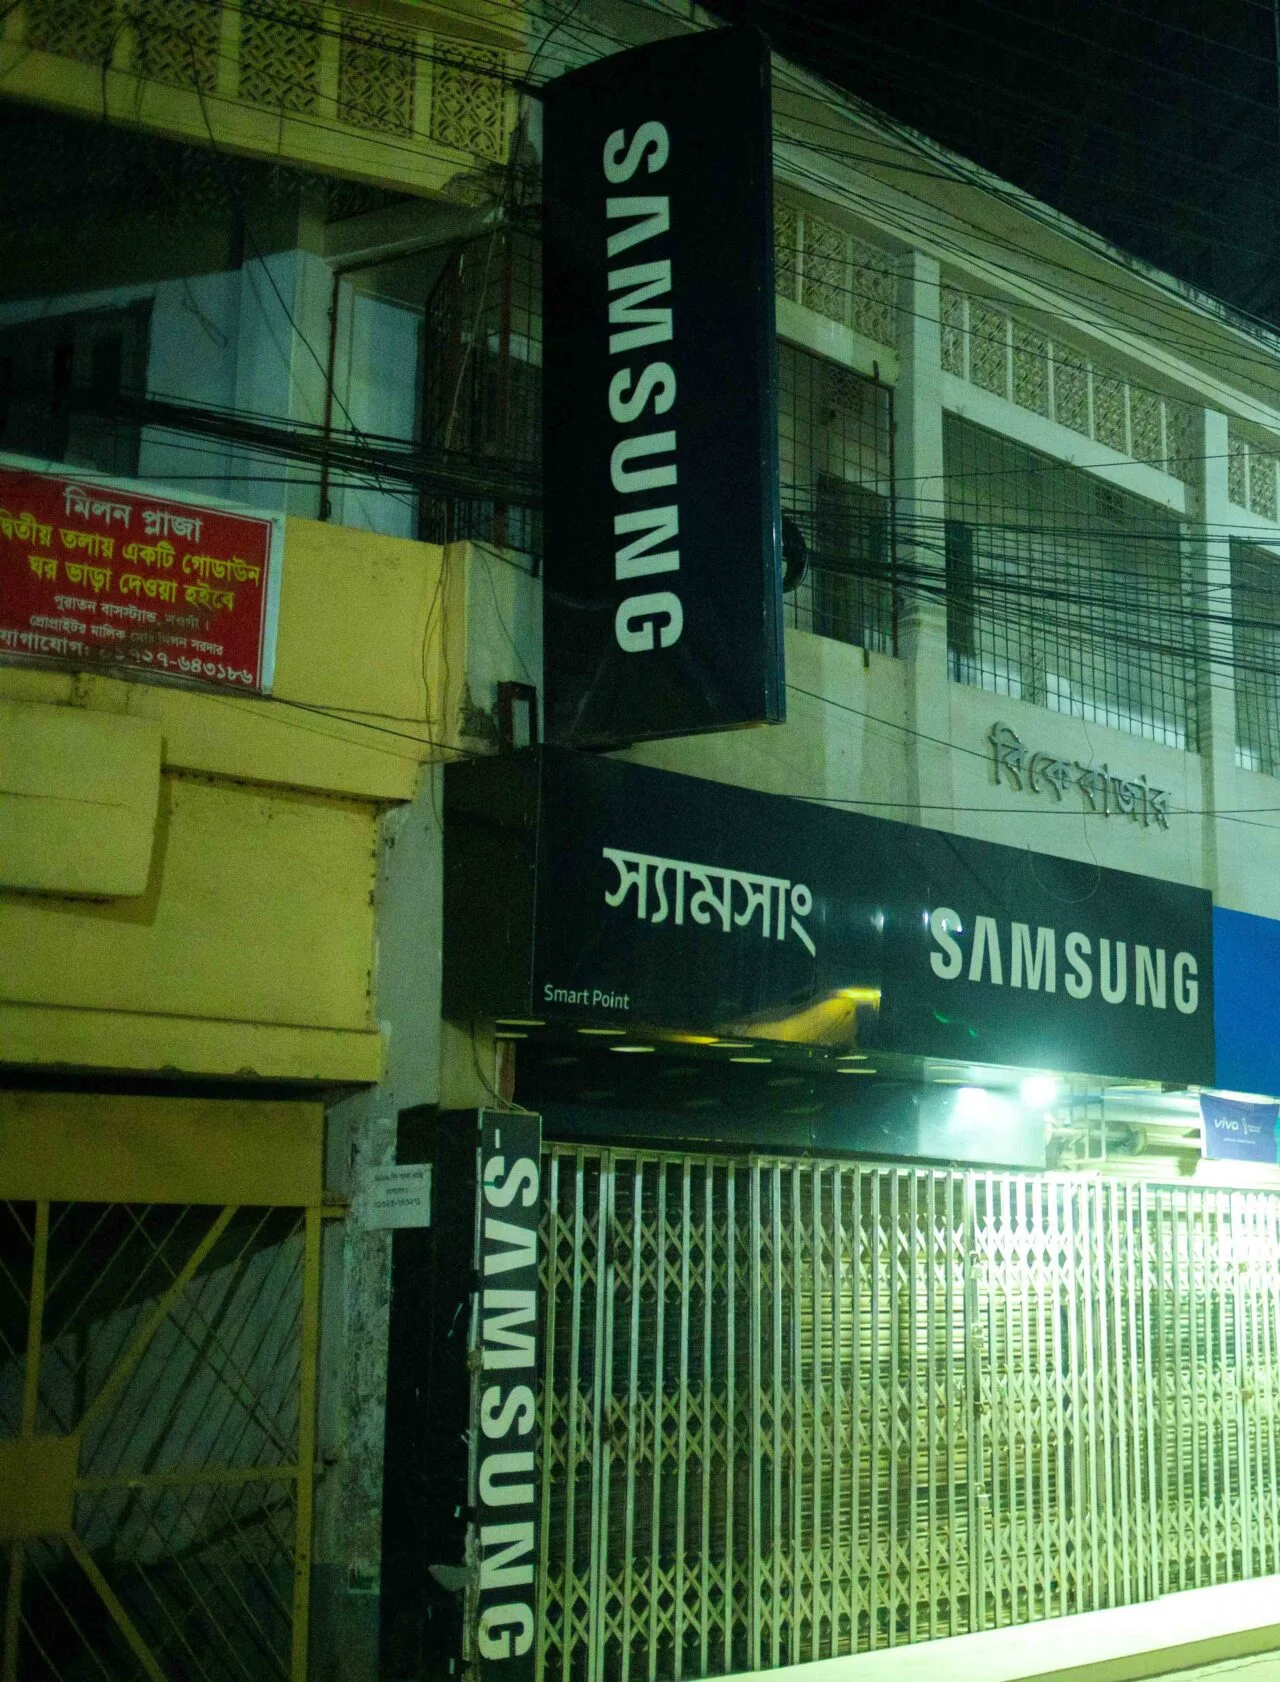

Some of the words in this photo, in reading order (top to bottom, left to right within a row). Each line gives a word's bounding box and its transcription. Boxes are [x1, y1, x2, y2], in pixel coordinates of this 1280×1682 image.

[602, 120, 685, 655] SAMSUNG
[63, 485, 132, 528] মিলন
[141, 509, 204, 544] প্লাজা
[28, 555, 58, 581] ঘর
[65, 562, 113, 593] ভাড়া
[119, 573, 178, 604] দেওয়া
[183, 580, 236, 612] হইবে
[59, 527, 115, 559] তলায়
[122, 540, 176, 568] একটি
[182, 553, 262, 588] গোডাউন
[54, 594, 97, 614] পুরাতন
[601, 846, 817, 958] স্যামসাং
[928, 906, 1201, 1016] SAMSUNG
[543, 983, 588, 1006] Smart
[591, 987, 631, 1010] Point
[477, 1156, 540, 1661] SAMSUNG
